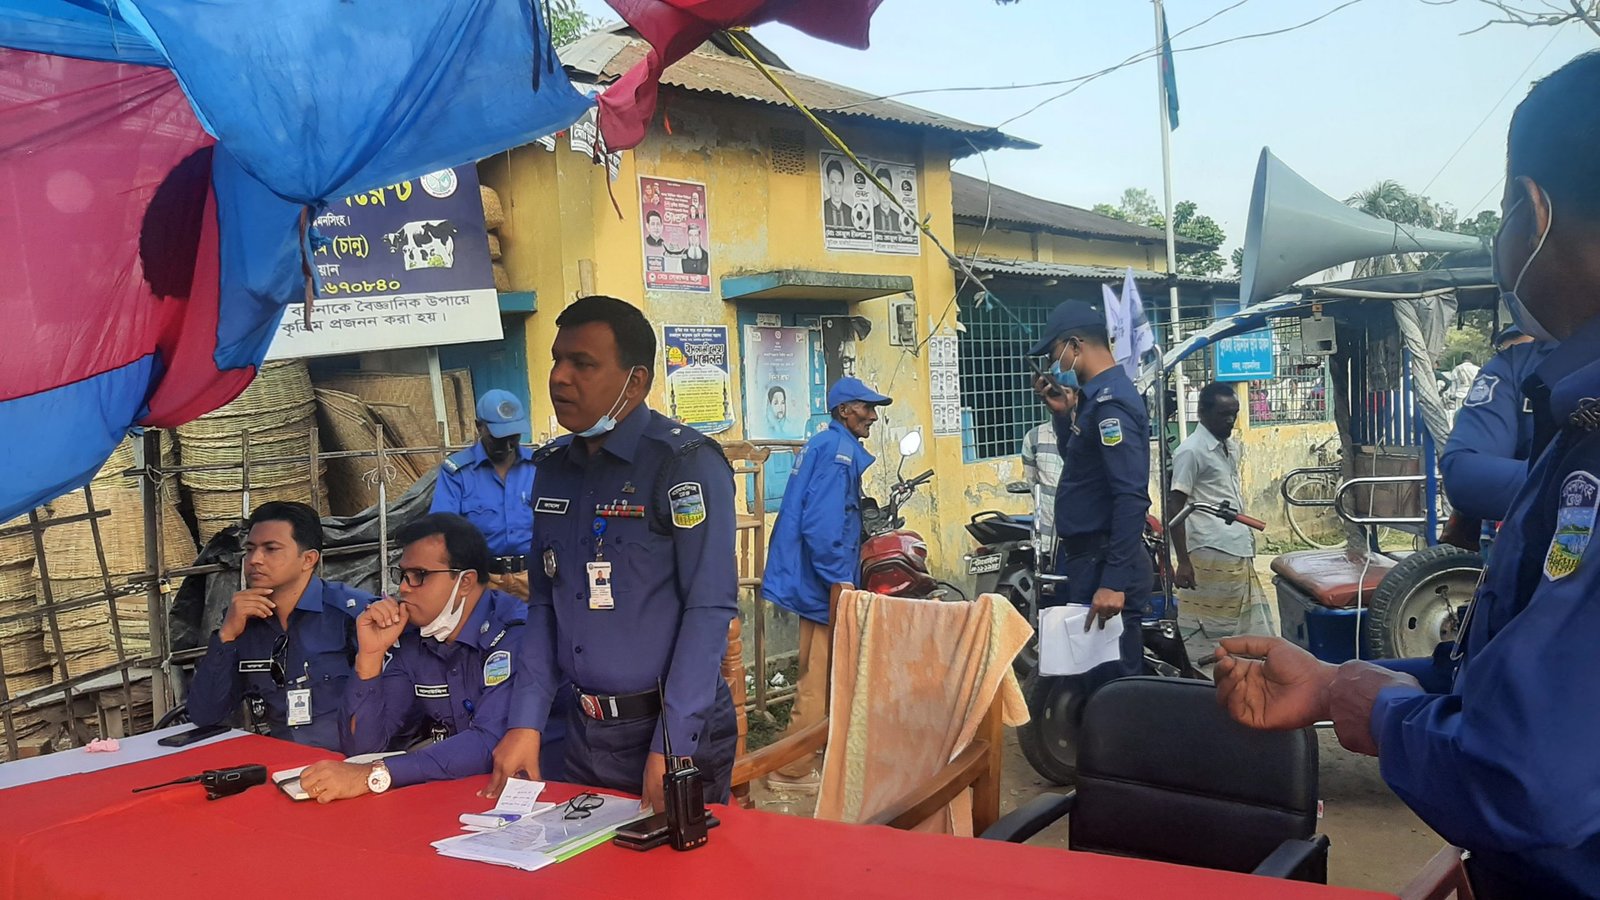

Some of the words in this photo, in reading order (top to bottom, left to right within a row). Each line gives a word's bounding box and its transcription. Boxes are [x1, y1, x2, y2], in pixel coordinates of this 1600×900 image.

[333, 234, 370, 259] (চানু)
[320, 279, 400, 294] -৬৭০৮৪০
[356, 296, 422, 312] বৈজ্ঞানিক
[425, 293, 470, 307] উপায়ে
[329, 315, 377, 330] প্রজনন
[383, 313, 410, 325] করা
